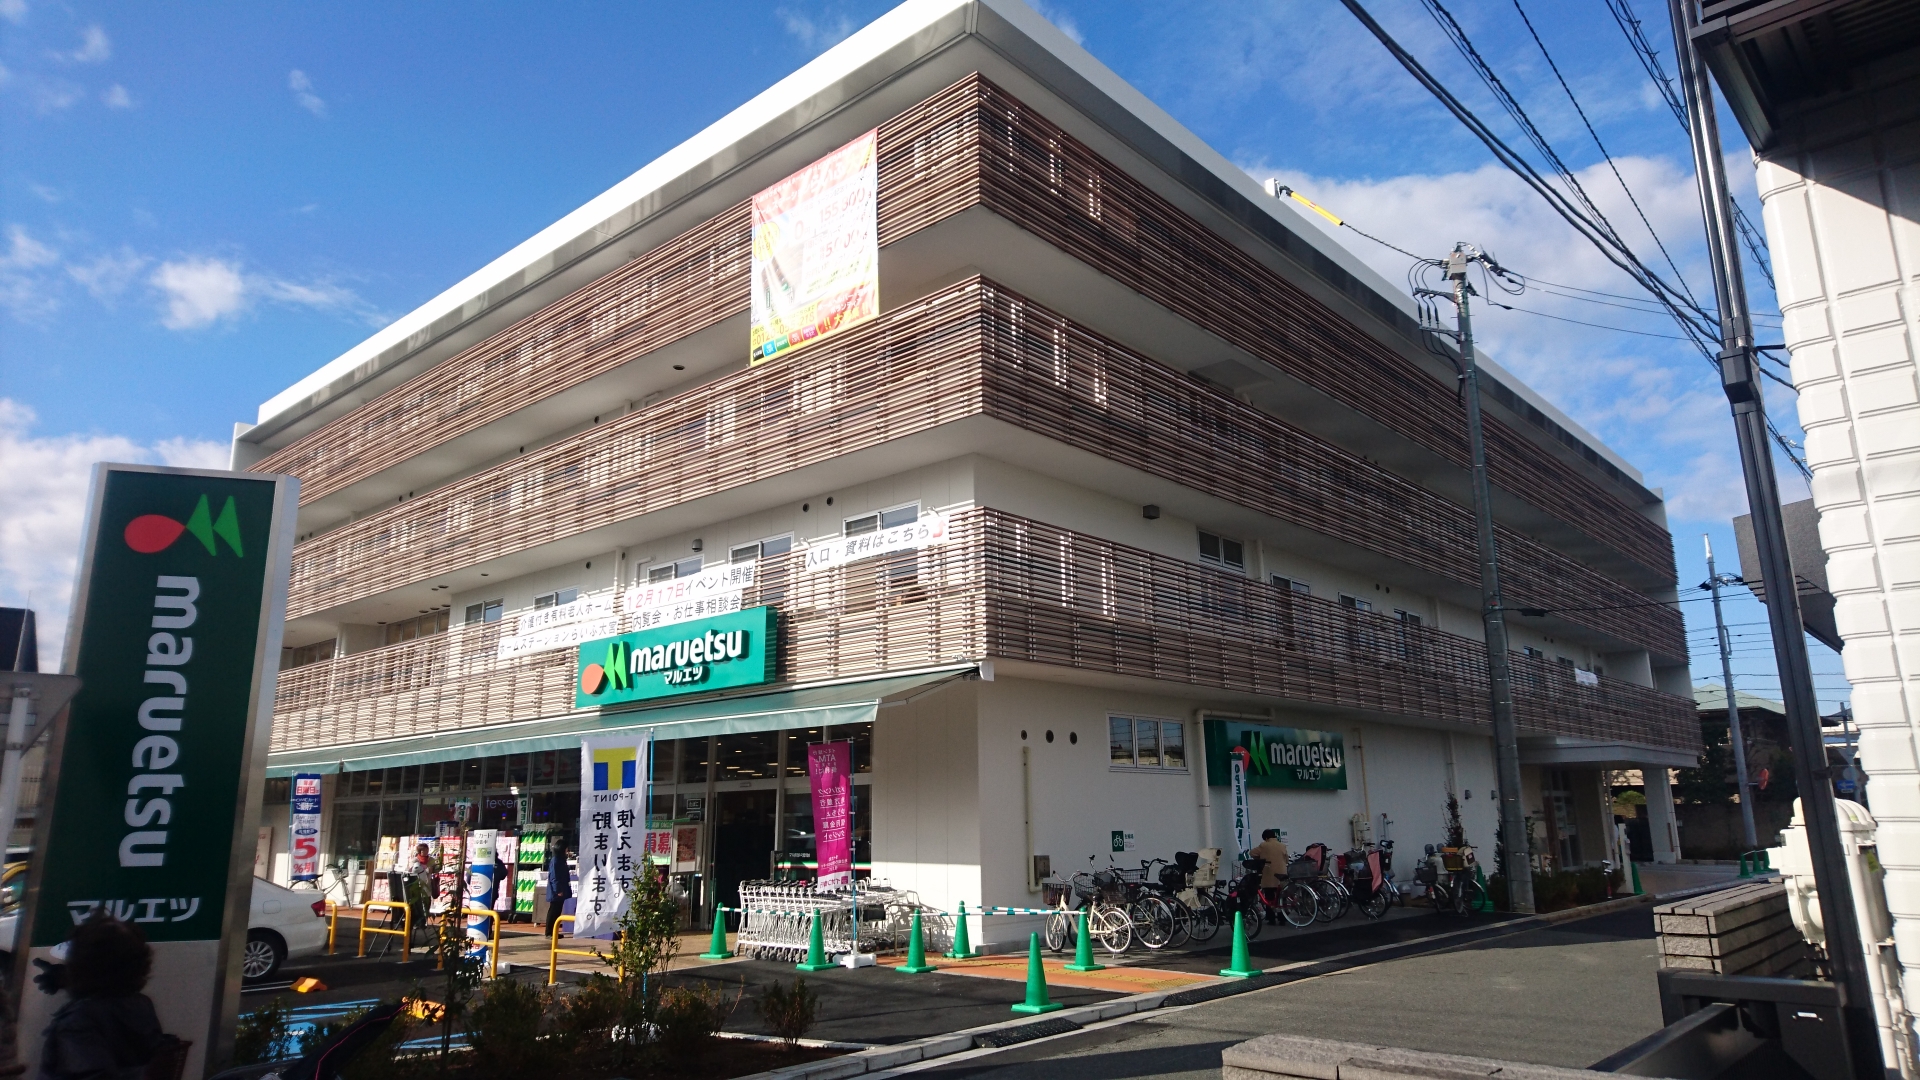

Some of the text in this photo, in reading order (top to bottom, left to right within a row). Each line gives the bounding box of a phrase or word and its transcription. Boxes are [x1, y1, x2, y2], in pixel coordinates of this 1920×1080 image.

[807, 524, 929, 568] 入口・資料はこちら
[627, 564, 754, 610] 12月17日イベント開催
[519, 603, 612, 632] 介護付き有料老人ホーム
[632, 594, 741, 630] 内覧会・お仕事相談会
[498, 620, 618, 655] ホームステーションらいふ大宮
[630, 629, 742, 674] maruetsu
[663, 667, 703, 685] マルエツ
[119, 575, 201, 867] maruetsu
[1270, 742, 1341, 768] maruetsu
[1297, 769, 1321, 780] マルエツ
[294, 838, 317, 860] 5
[293, 862, 316, 873] %引
[67, 897, 200, 925] マルエツ
